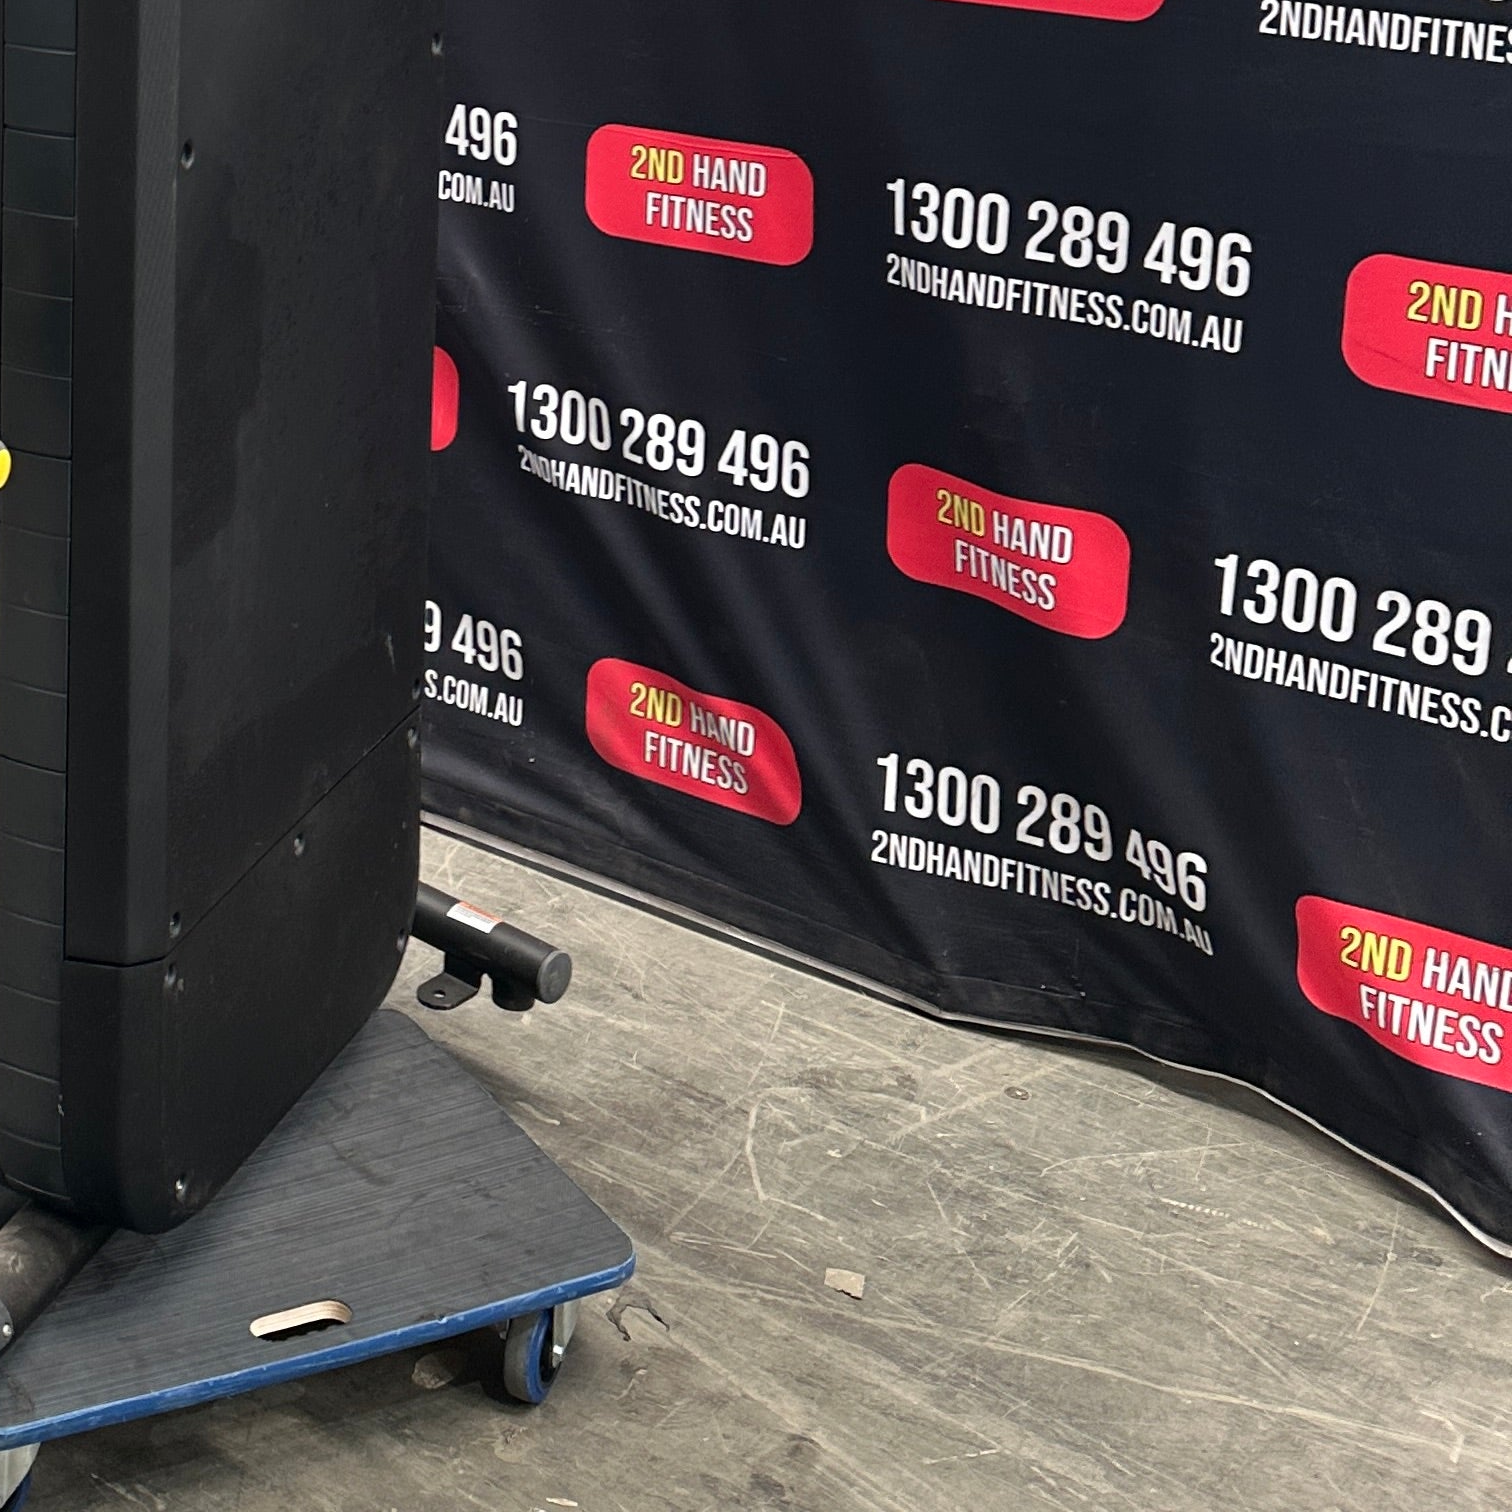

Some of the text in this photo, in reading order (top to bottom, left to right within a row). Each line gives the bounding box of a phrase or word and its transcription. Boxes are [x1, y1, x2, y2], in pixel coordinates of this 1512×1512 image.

[445, 103, 519, 167] 496
[630, 144, 767, 198] 2ND HAND
[437, 169, 516, 214] COM.AU
[645, 192, 754, 242] FITNESS
[886, 178, 1253, 297] 1300 289 496
[886, 253, 1244, 354] 2NDHANDFITNESS.COM.AU
[1406, 280, 1484, 331] 2ND
[507, 380, 811, 499] 1300 289 496
[517, 444, 807, 549] 2NDHANDFITNESS.COM.AU
[937, 489, 1074, 565] 2ND HAND
[954, 538, 1057, 611] FITNESS
[451, 613, 524, 681] 496
[1214, 553, 1492, 677] 1300 289
[629, 682, 755, 757] 2ND HAND
[644, 730, 749, 795] FITNESS
[876, 752, 1208, 913] 1300 289 496
[871, 829, 1214, 957] 2NDHANDFITNESS.COM.AU
[1340, 925, 1413, 983] 2ND
[1359, 983, 1505, 1065] FITNESS
